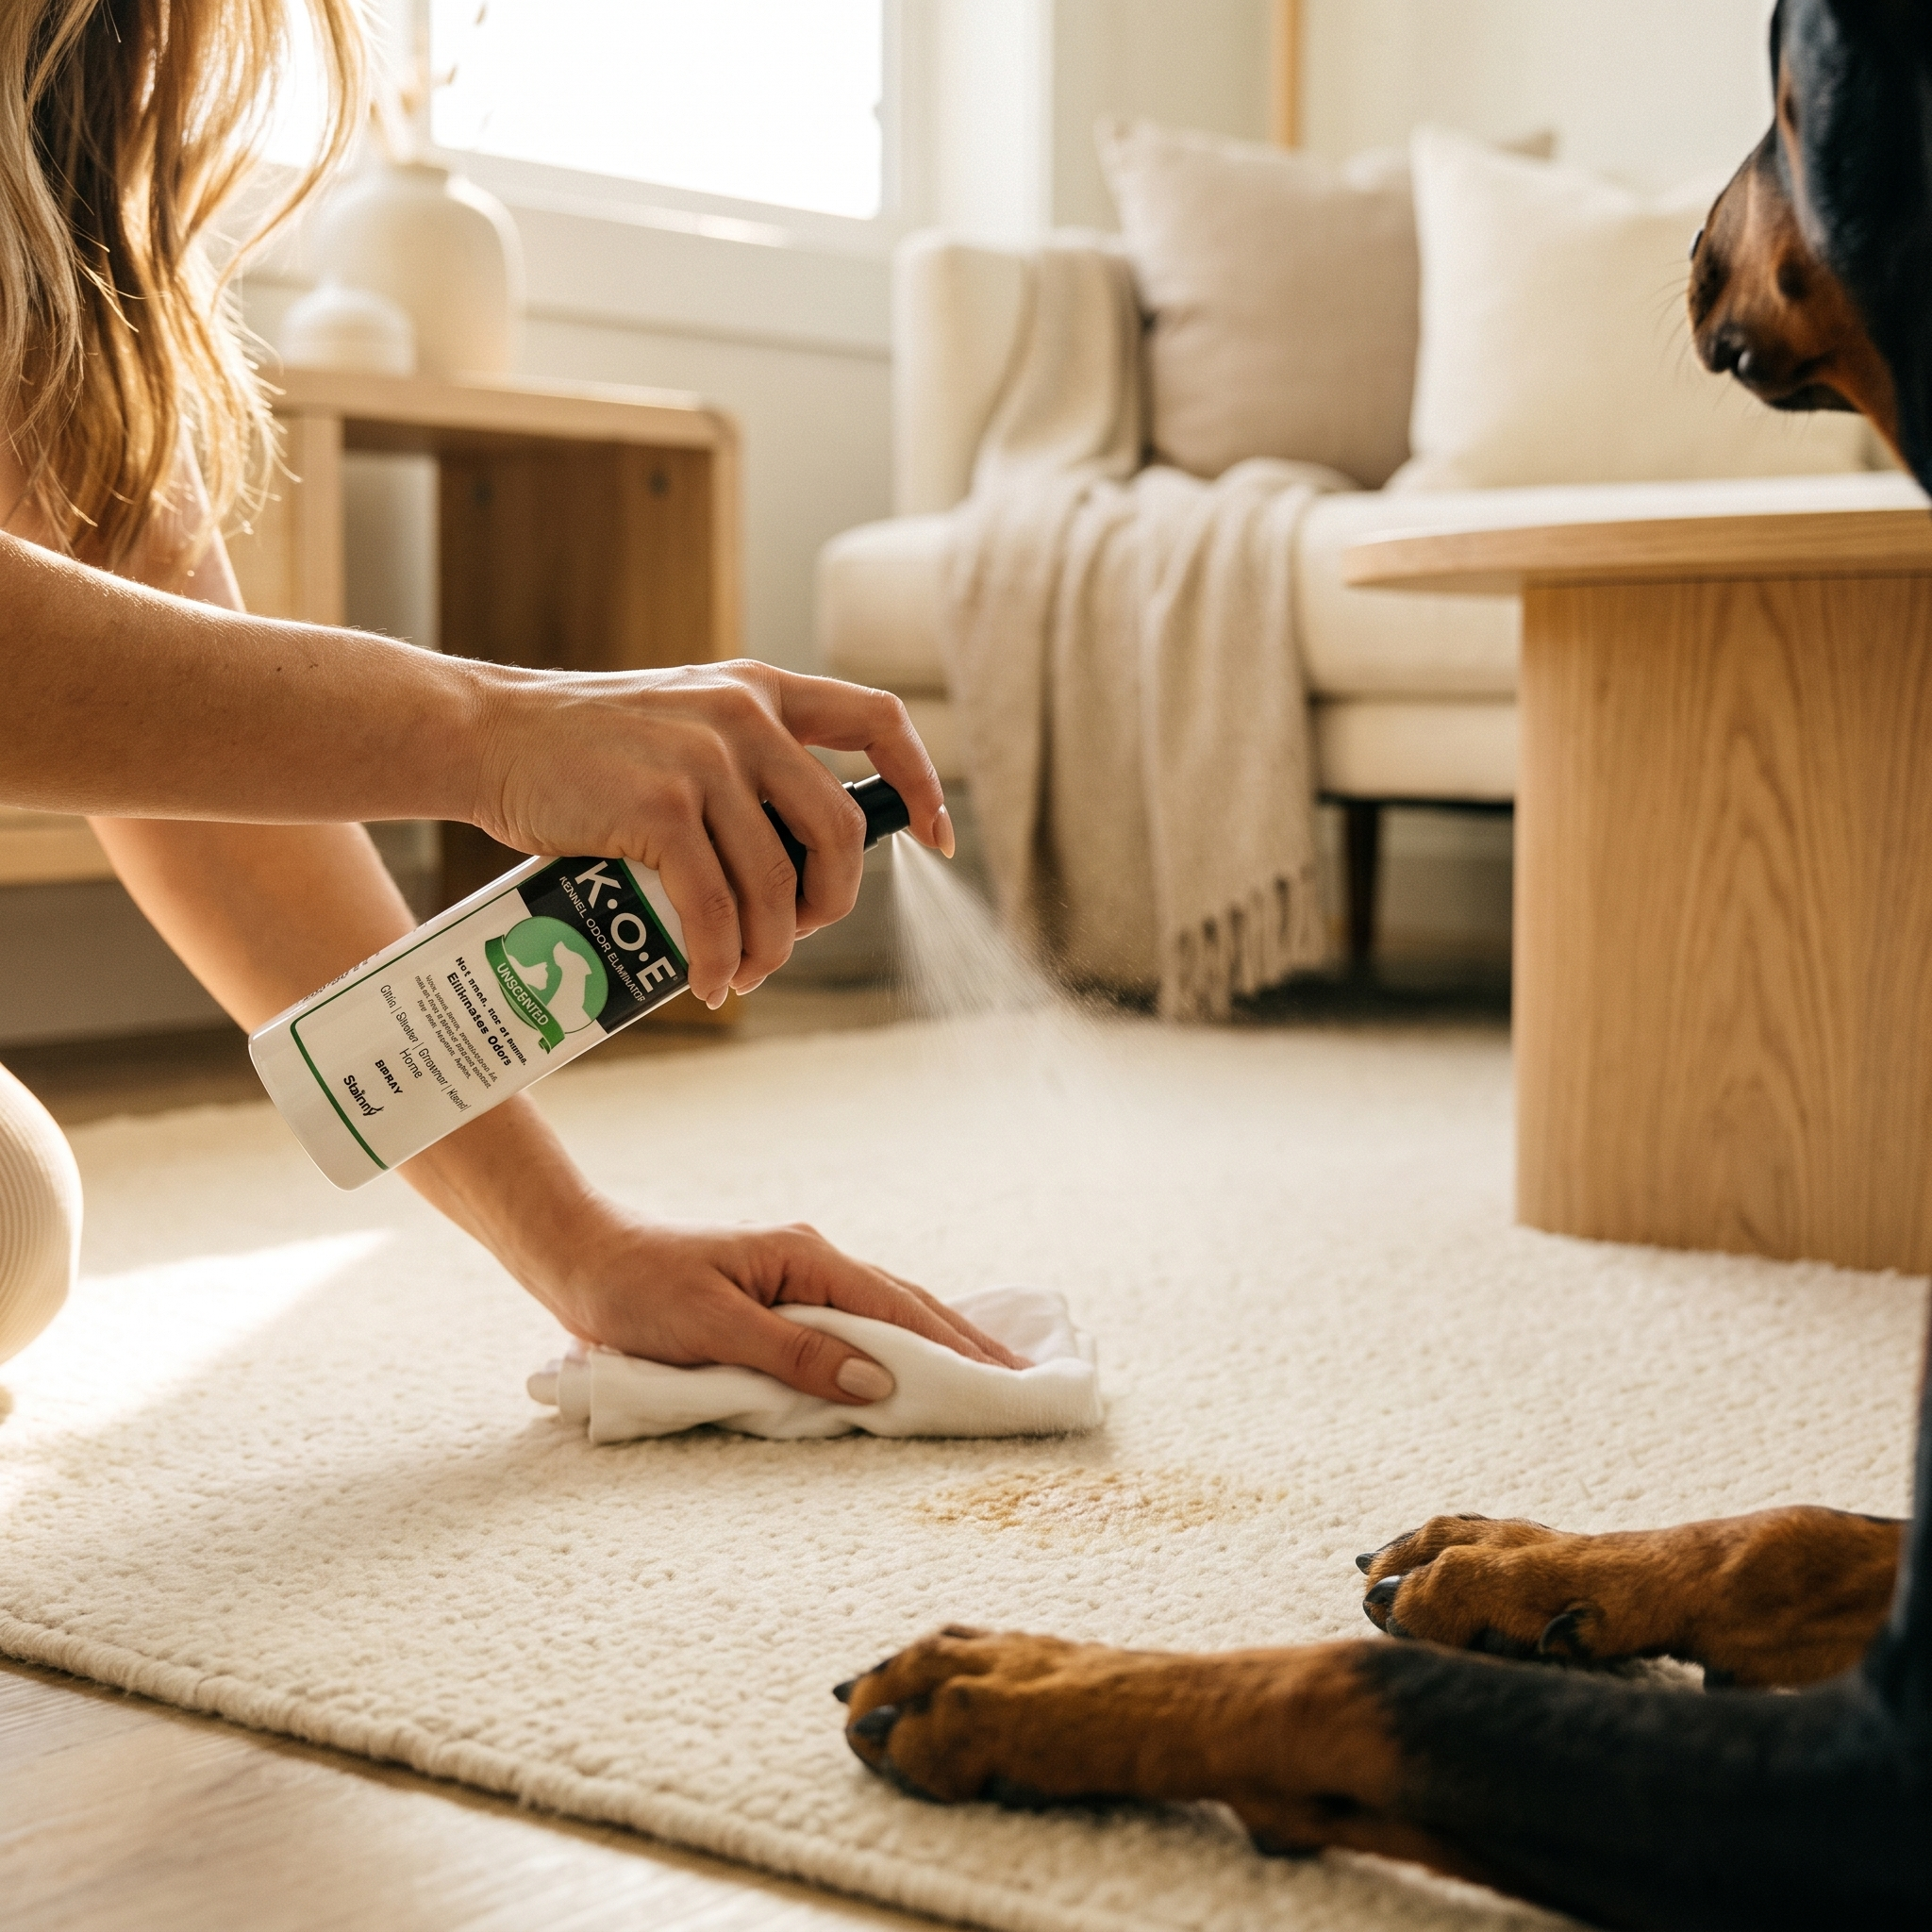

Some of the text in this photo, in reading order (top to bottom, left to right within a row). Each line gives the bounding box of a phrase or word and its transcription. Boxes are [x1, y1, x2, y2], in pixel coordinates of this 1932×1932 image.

[586, 918, 610, 952] ODOR
[399, 1047, 423, 1078] Home
[487, 1035, 511, 1065] Odors
